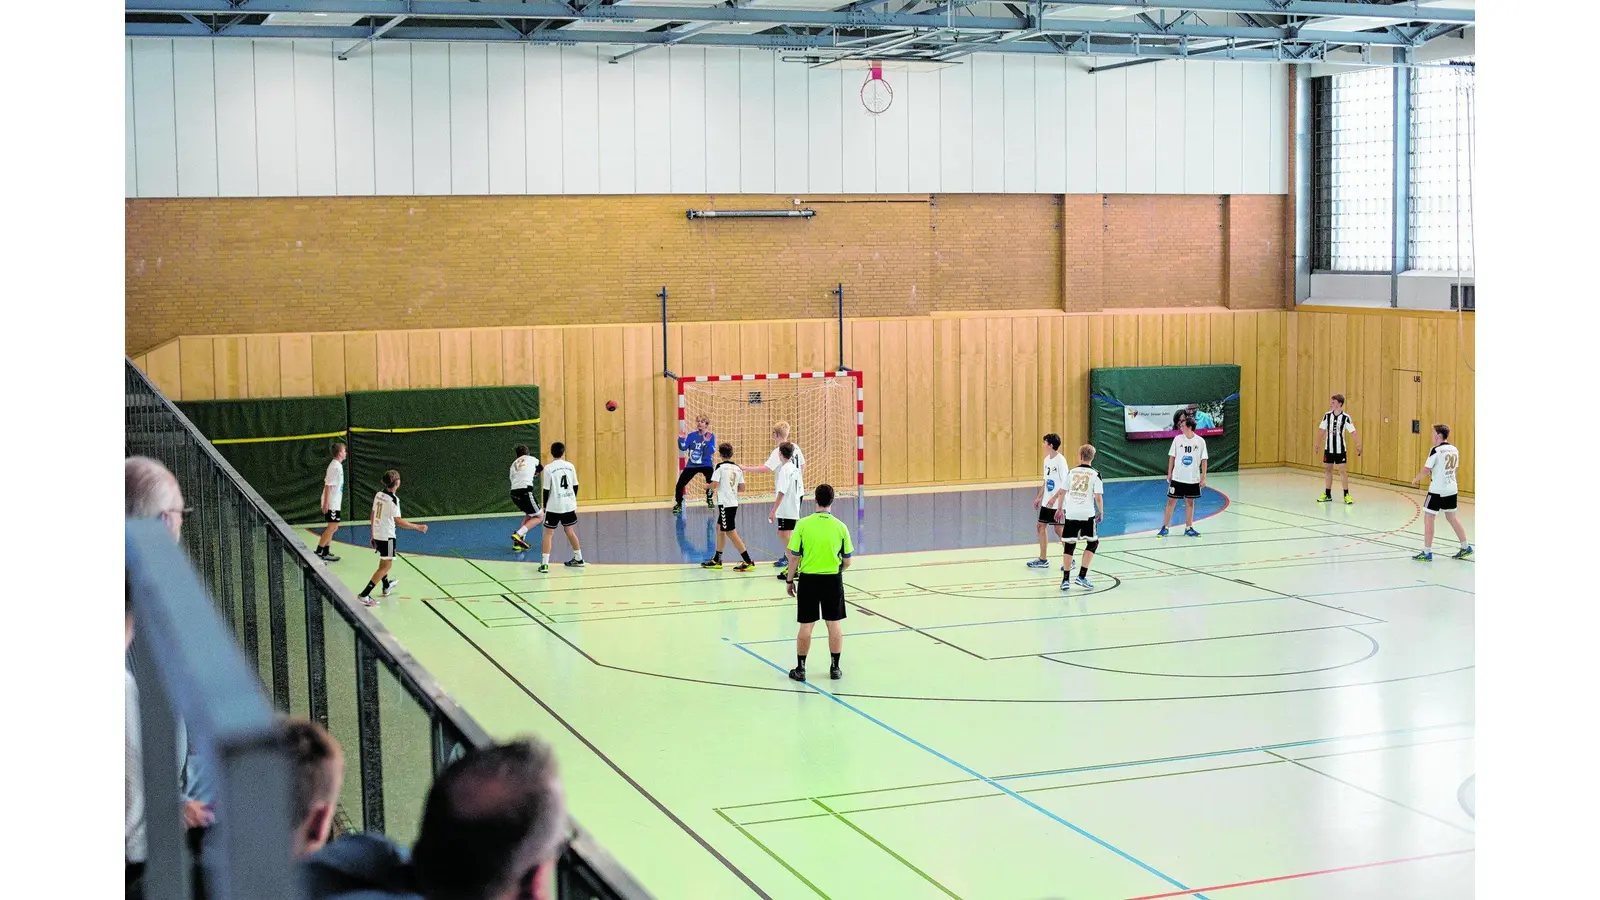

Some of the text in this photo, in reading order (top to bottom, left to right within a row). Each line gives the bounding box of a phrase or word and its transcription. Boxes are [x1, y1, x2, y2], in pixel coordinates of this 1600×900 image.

[1184, 445, 1192, 453] 10
[1444, 453, 1457, 470] 20
[560, 474, 568, 490] 4
[1071, 474, 1090, 492] 23
